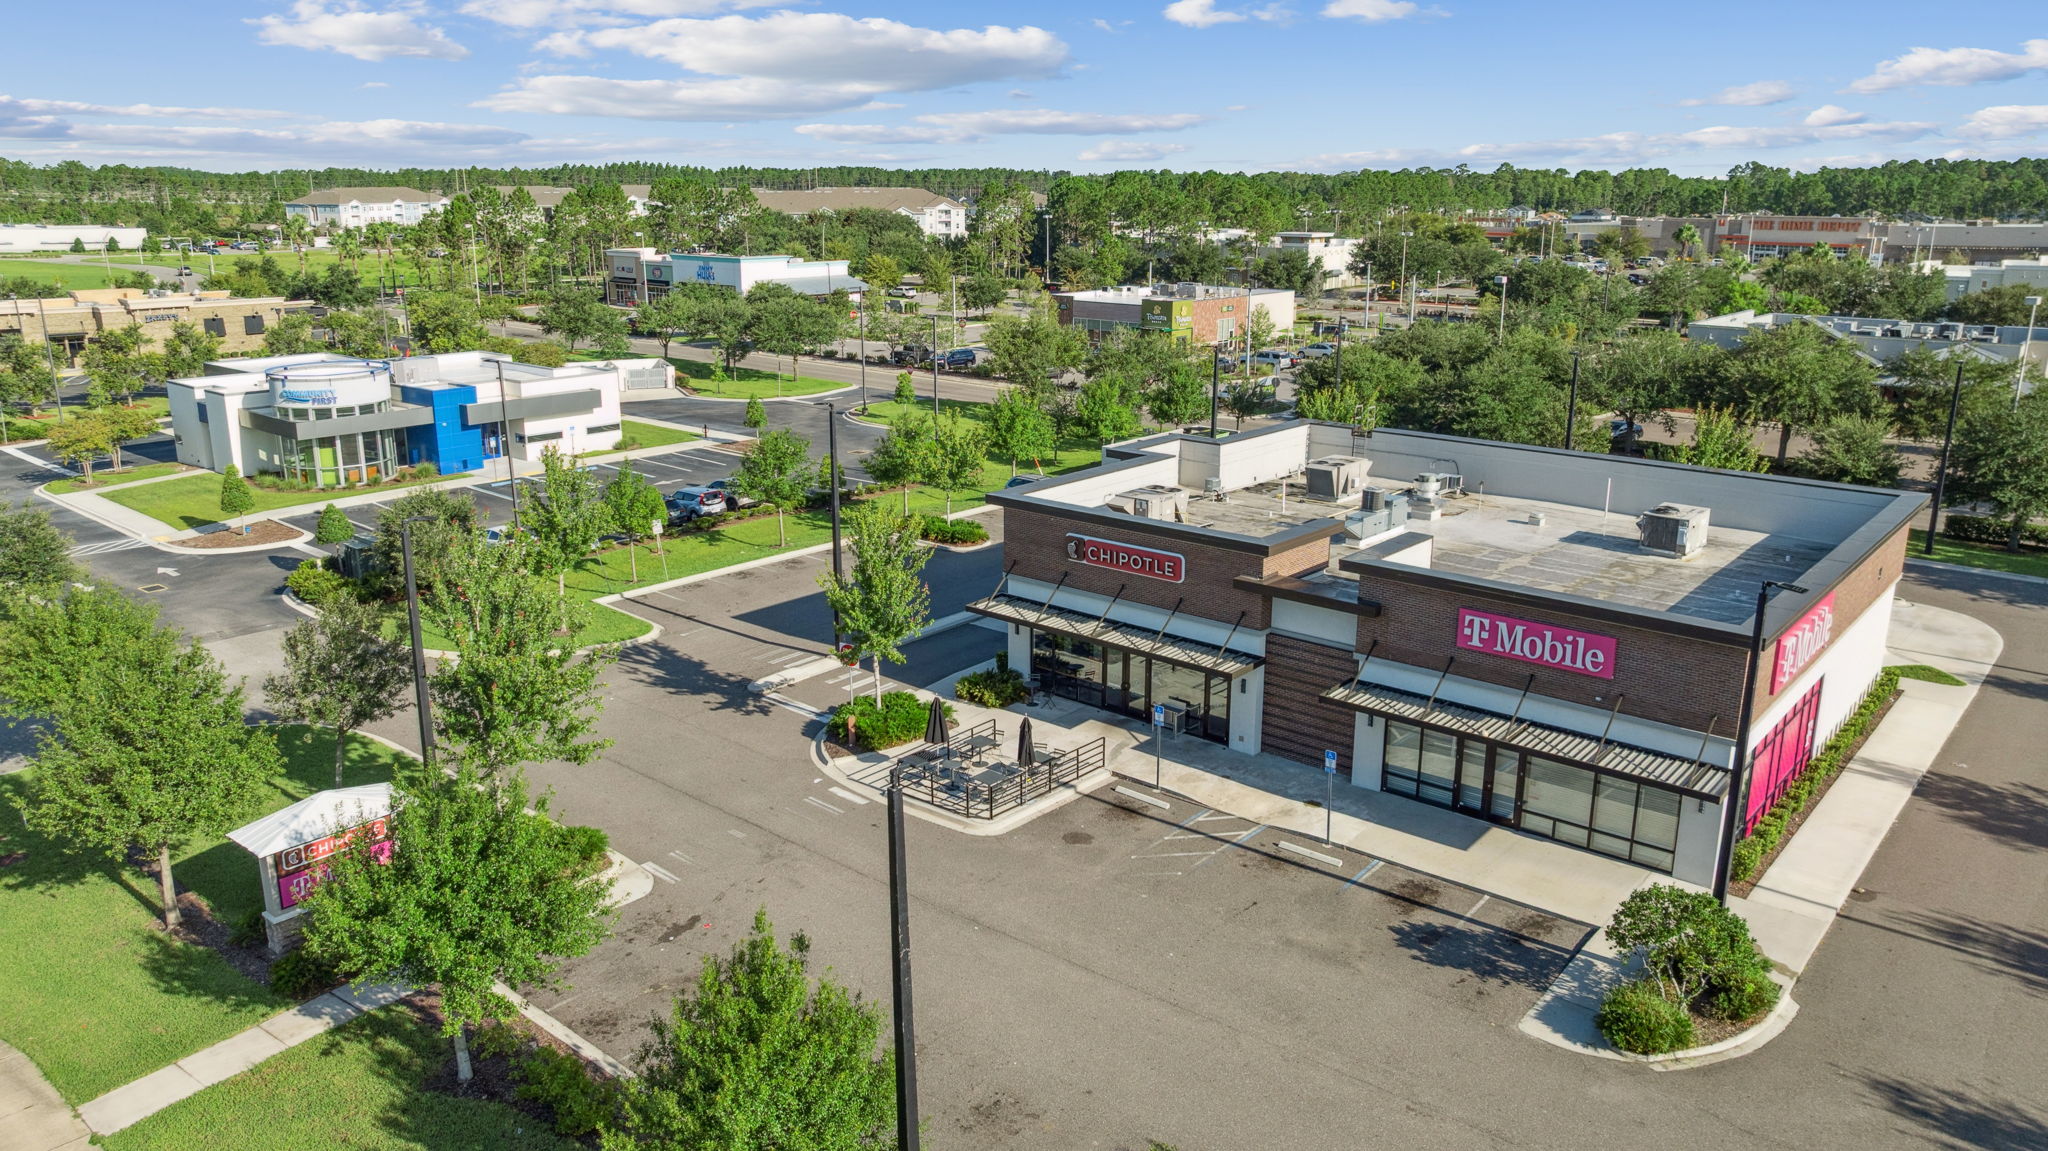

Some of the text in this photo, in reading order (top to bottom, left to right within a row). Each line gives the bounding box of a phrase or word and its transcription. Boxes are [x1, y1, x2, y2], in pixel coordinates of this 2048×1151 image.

[312, 396, 337, 405] FIRST
[1087, 546, 1174, 576] CHIPOTLE
[1493, 621, 1605, 673] Mobile
